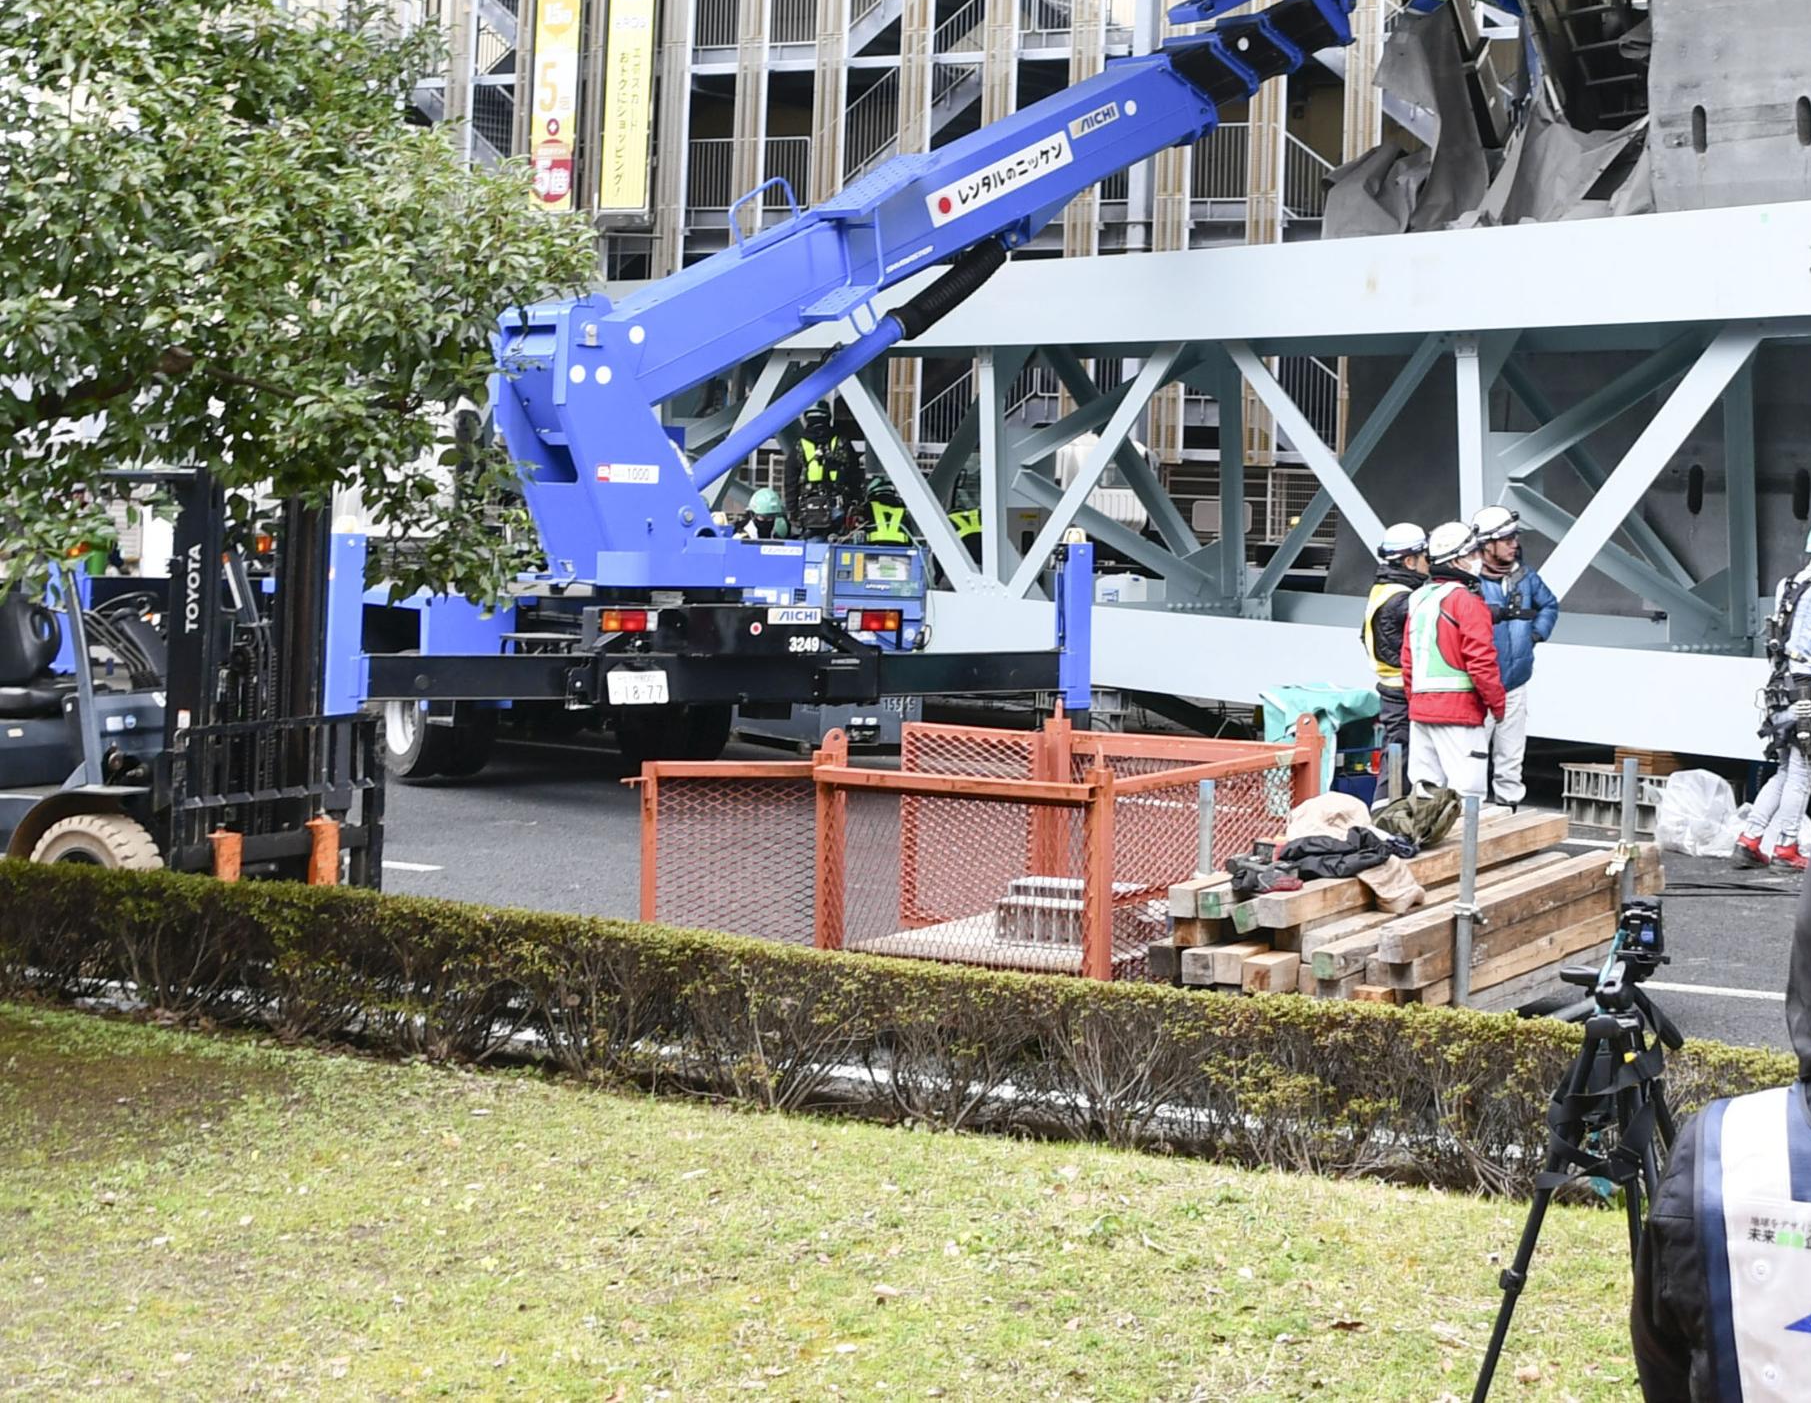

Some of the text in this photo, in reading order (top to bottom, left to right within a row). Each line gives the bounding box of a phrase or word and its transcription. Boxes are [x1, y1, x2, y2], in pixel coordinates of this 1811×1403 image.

[1079, 105, 1117, 133] AICHI
[958, 142, 1063, 205] レンタルのニッケン
[184, 543, 202, 634] TOYOTA
[778, 610, 818, 622] AICHI
[788, 637, 820, 653] 3249
